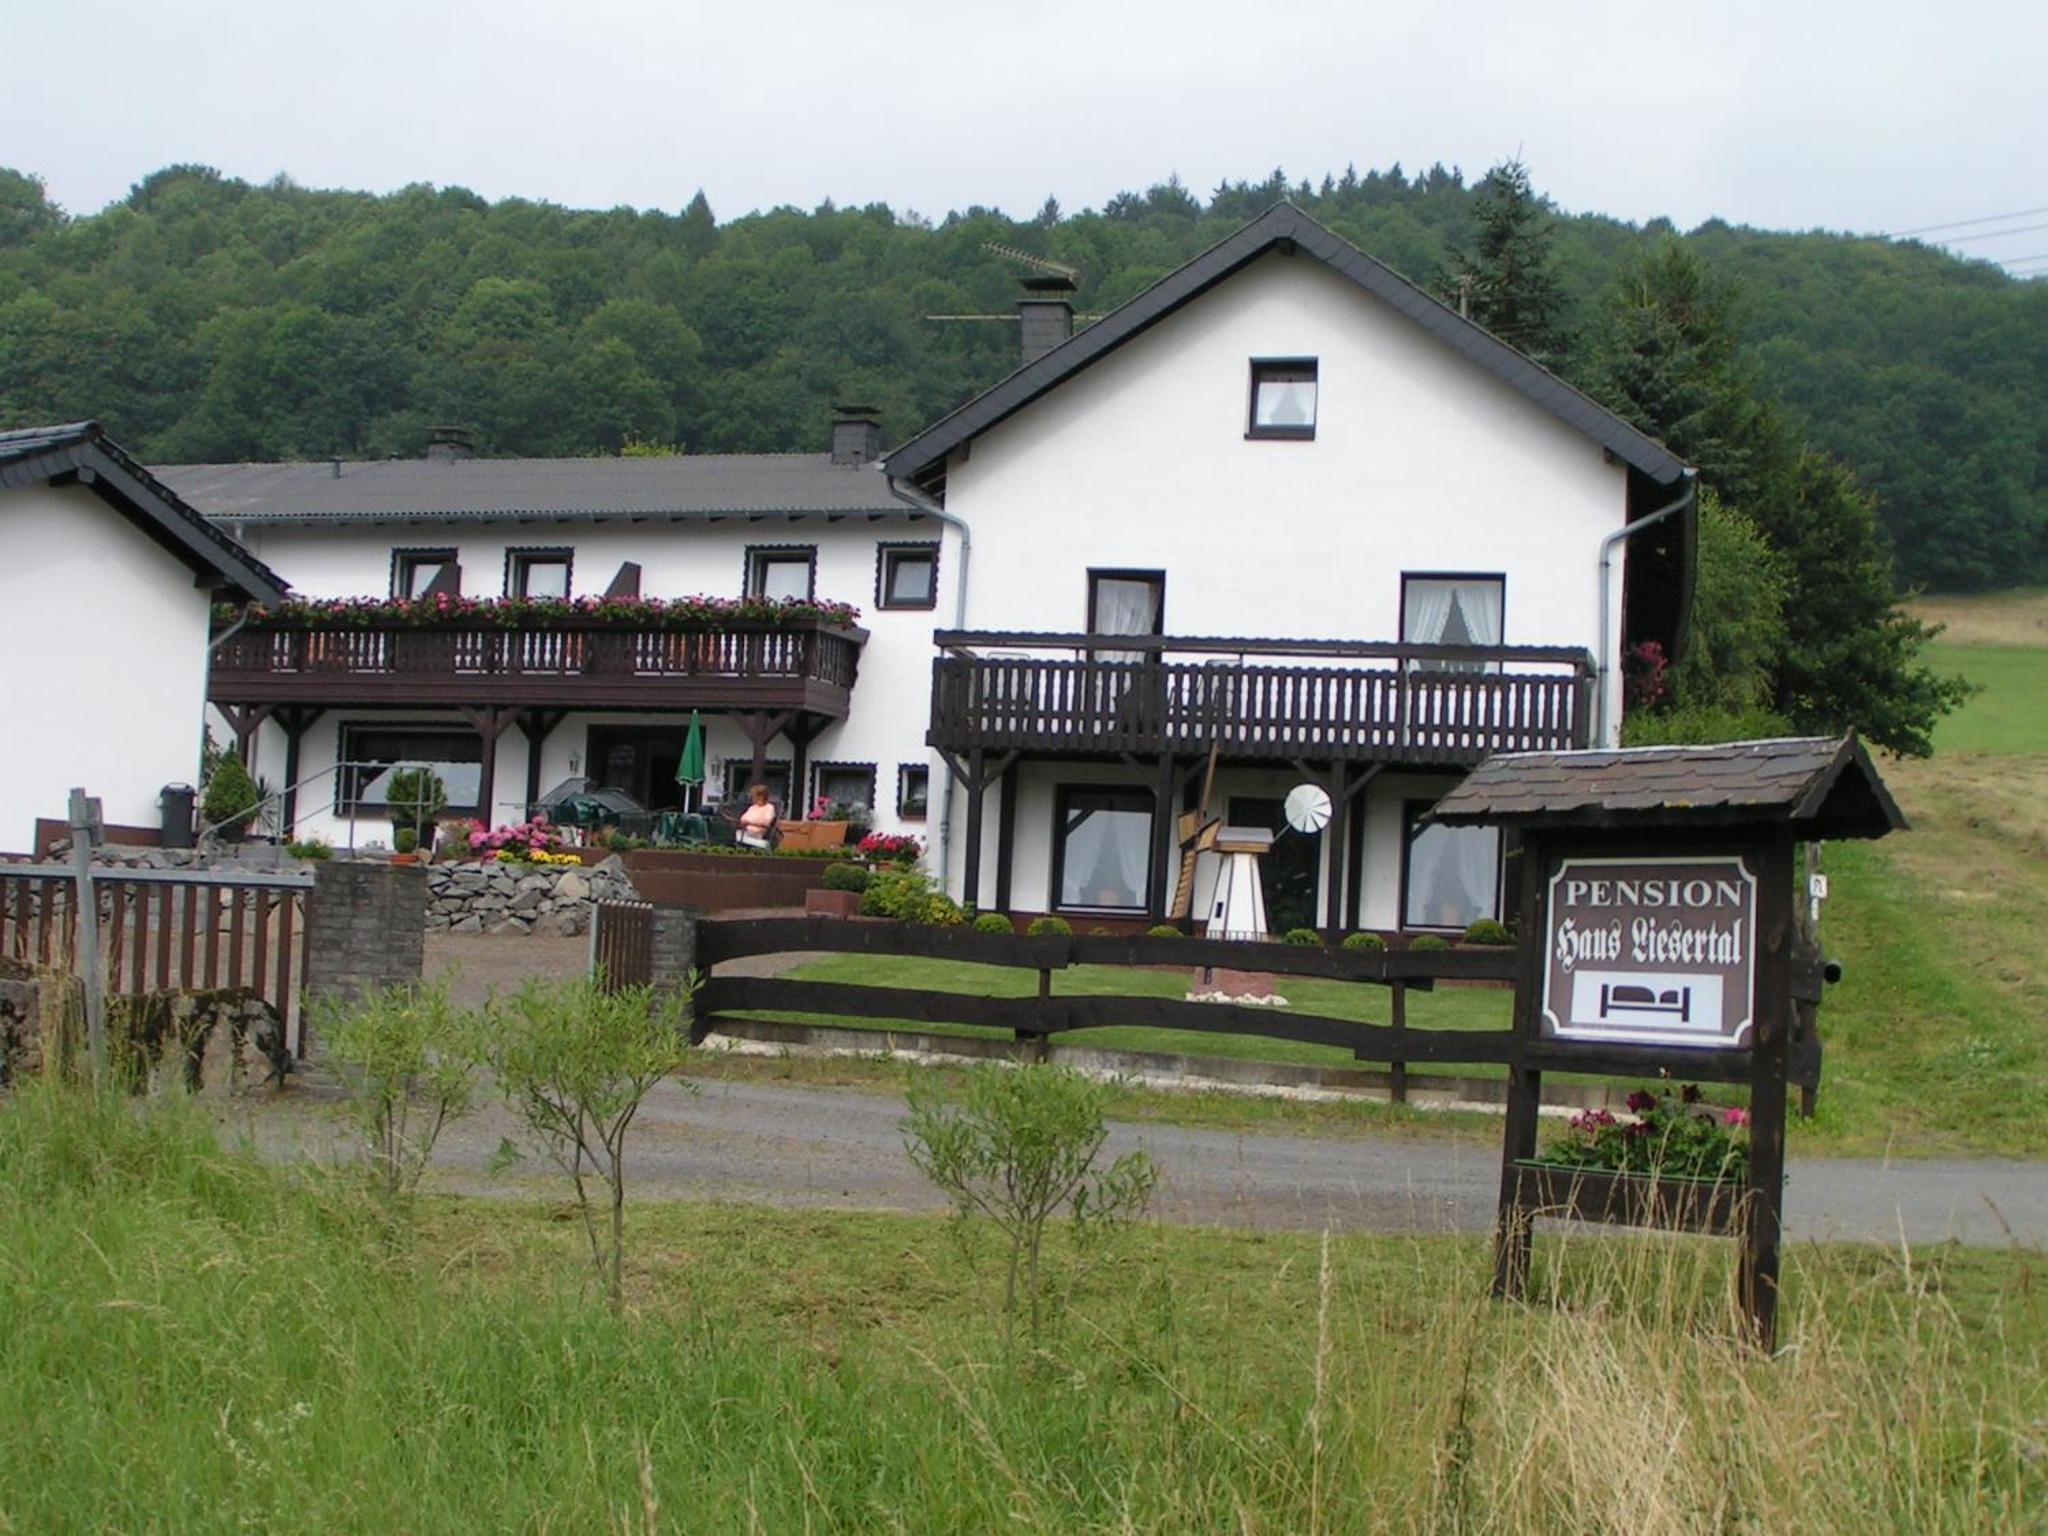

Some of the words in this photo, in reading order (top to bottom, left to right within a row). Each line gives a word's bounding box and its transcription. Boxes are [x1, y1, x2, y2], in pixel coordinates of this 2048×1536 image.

[1566, 880, 1743, 907] PENSION
[1556, 917, 1622, 974] Haus
[1631, 917, 1744, 964] Liesertal
